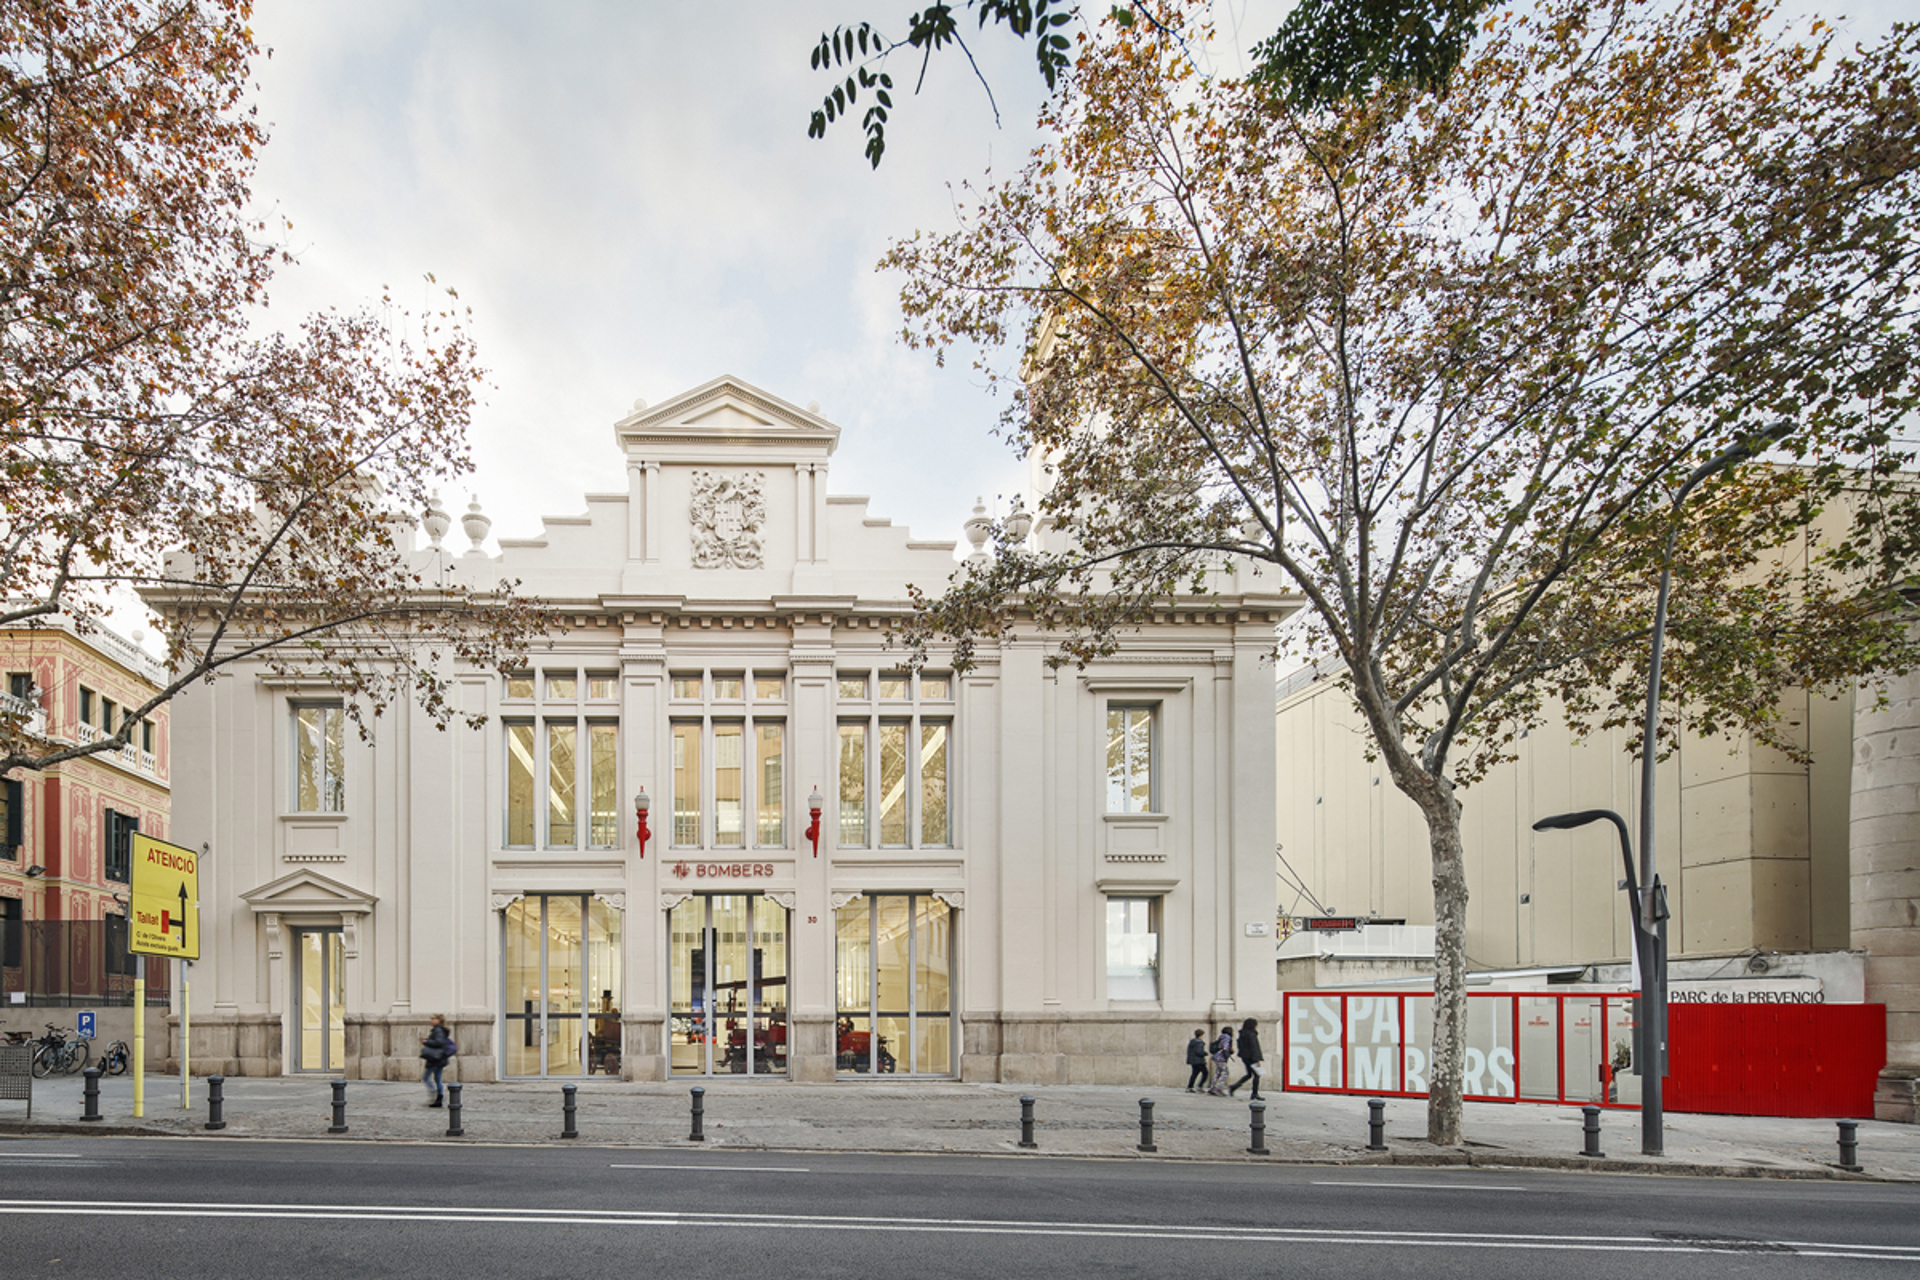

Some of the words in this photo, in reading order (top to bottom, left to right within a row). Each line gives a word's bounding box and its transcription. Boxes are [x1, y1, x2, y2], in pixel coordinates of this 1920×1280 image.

[147, 848, 194, 874] ATENCIÓ
[696, 864, 774, 877] BOMBERS
[136, 911, 159, 926] Tallat
[807, 916, 818, 924] 30
[1311, 919, 1355, 929] BOMBERS
[1670, 991, 1708, 1003] PARC
[1711, 991, 1728, 1003] de
[1732, 991, 1744, 1003] la
[1748, 989, 1825, 1003] PREVENCIÓ
[82, 1015, 91, 1026] P
[1289, 996, 1415, 1044] ESPAI
[1289, 1046, 1515, 1097] BOMBRS
